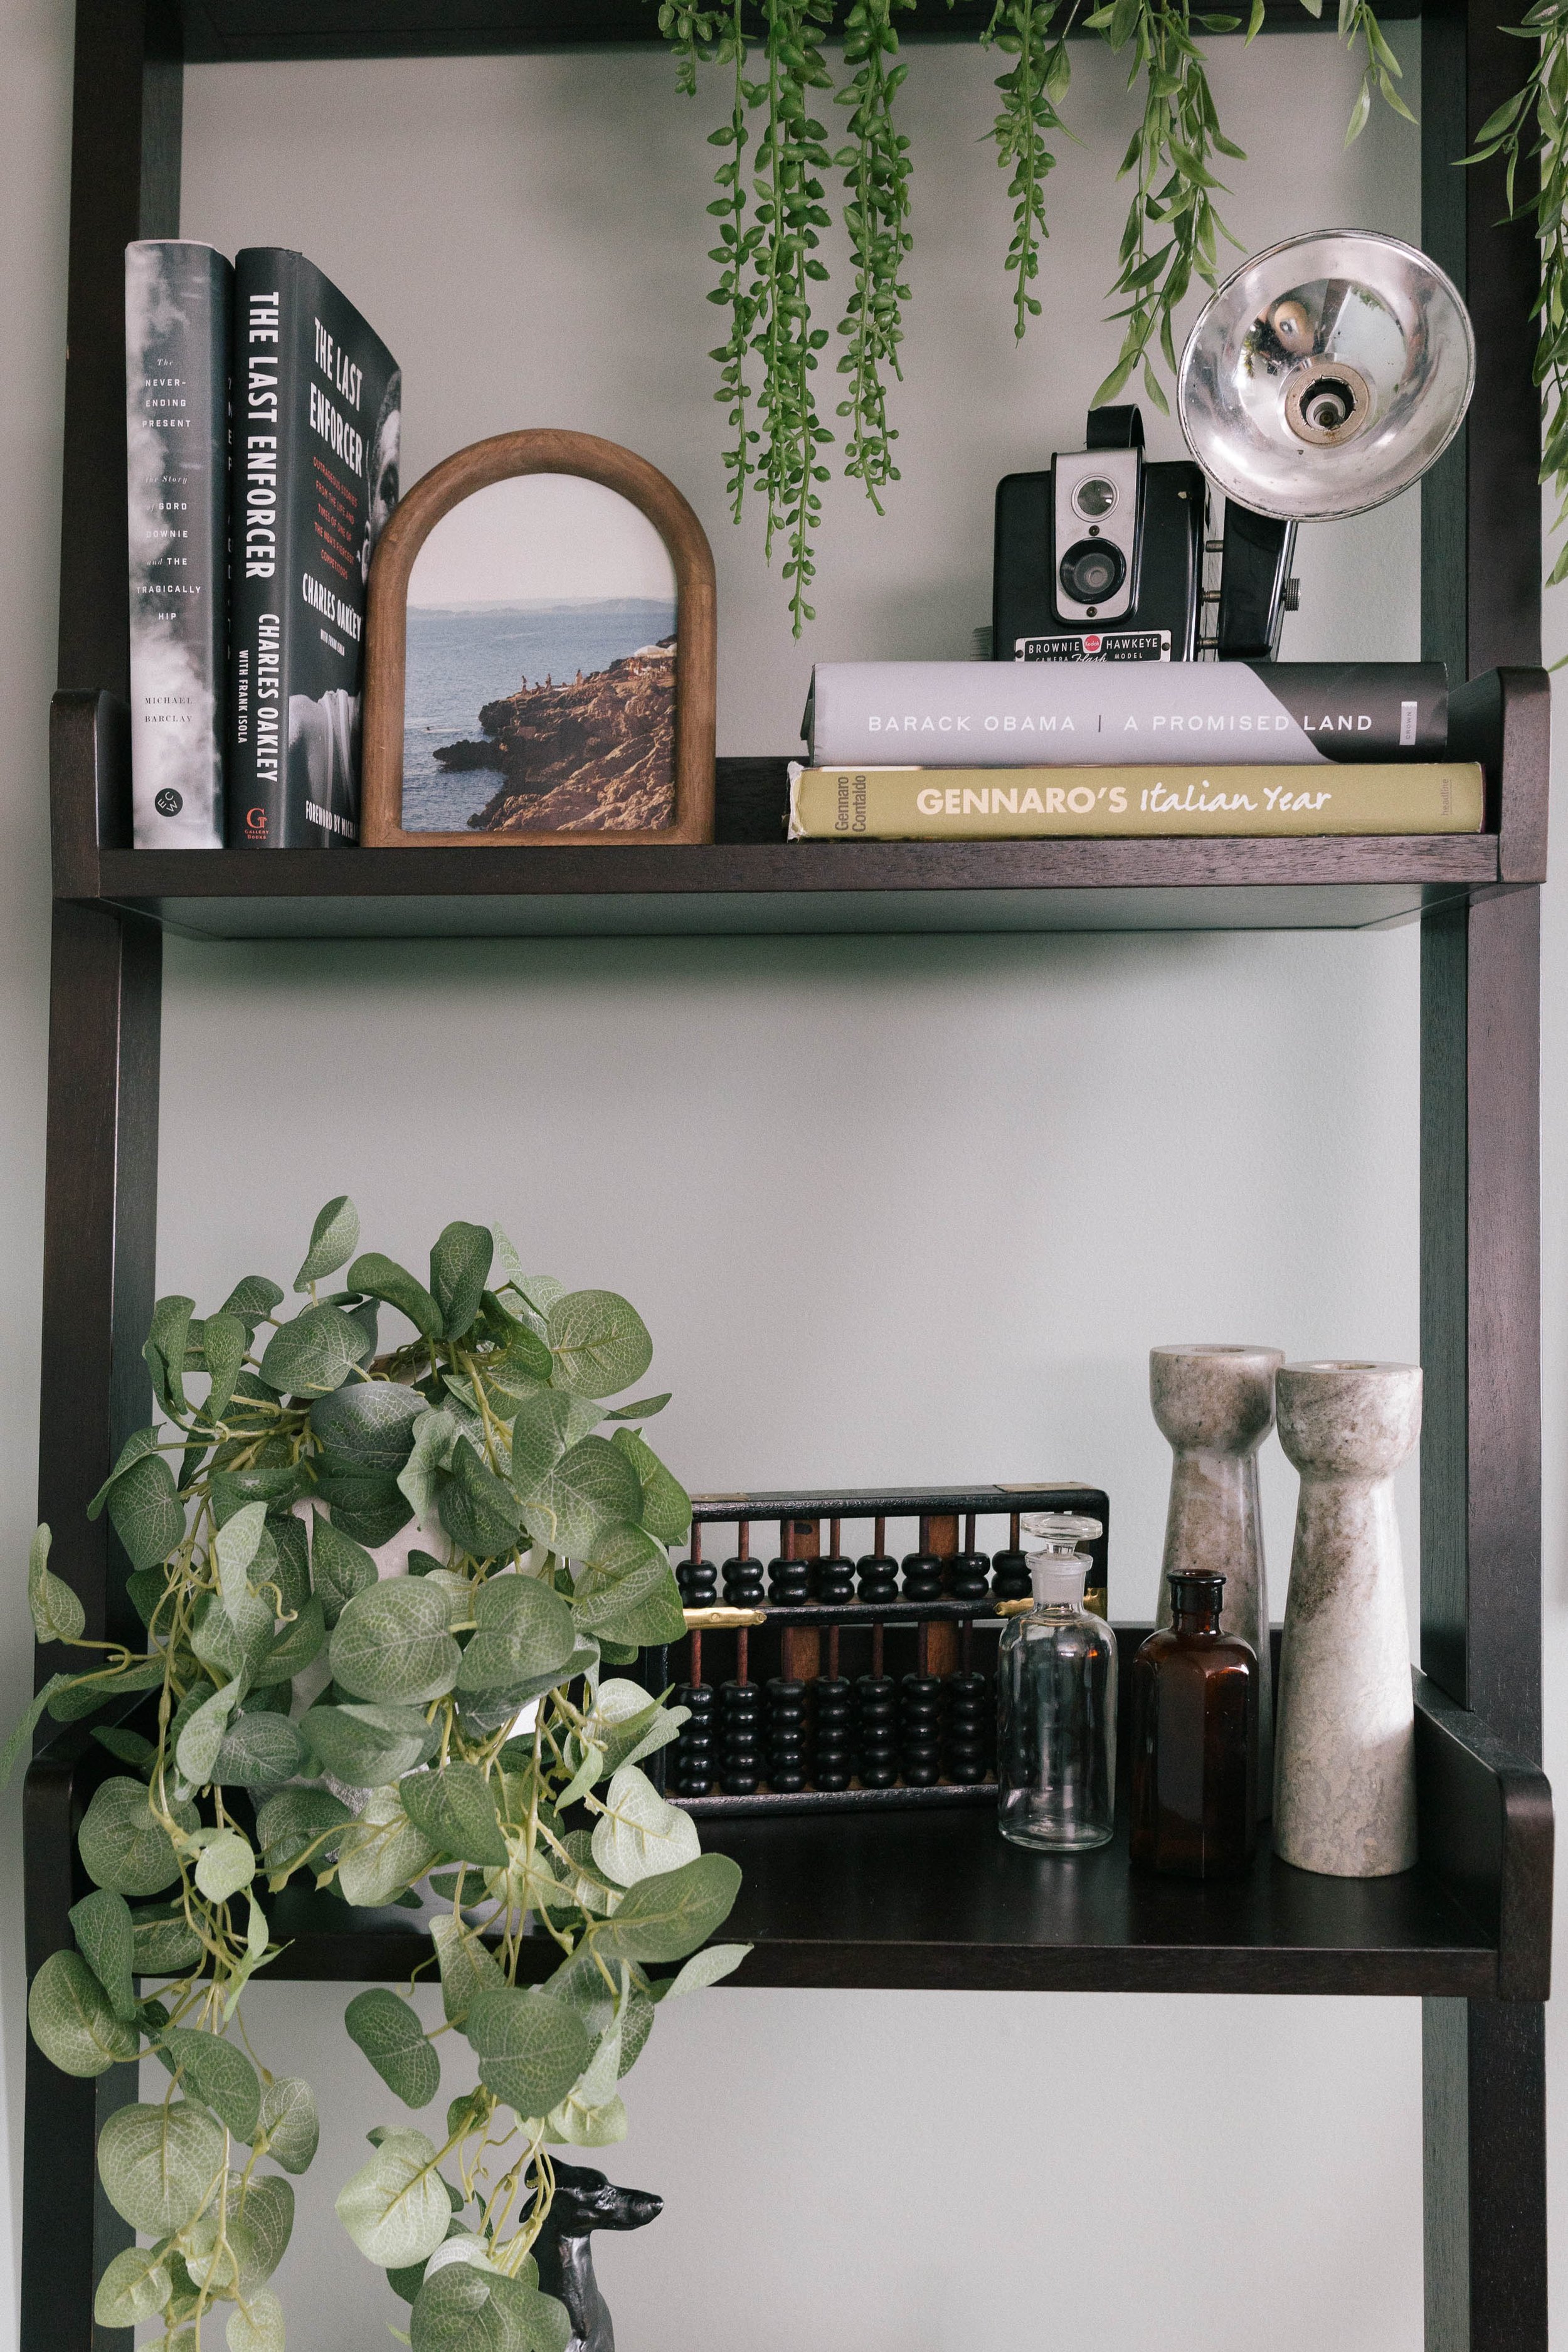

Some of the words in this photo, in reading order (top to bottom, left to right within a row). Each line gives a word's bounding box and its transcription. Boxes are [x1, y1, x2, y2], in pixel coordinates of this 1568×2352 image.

[249, 292, 279, 343] THE
[315, 317, 333, 381] THE
[336, 346, 363, 411] LAST
[248, 356, 278, 423] LAST
[142, 420, 191, 428] PRESENT
[310, 381, 363, 478] ENFORCER
[162, 475, 188, 484] Story
[159, 502, 188, 511] GORD
[246, 435, 277, 578] ENFORCER
[167, 558, 188, 566] THE
[137, 586, 201, 594] TRAGICALLY
[302, 573, 336, 622] CHARLES
[337, 599, 361, 642] OAKLEY
[257, 613, 280, 699] CHARLES
[1029, 642, 1079, 654] BROWNIE
[1071, 653, 1107, 662] Flash
[1106, 638, 1158, 649] HAWKEYE
[239, 650, 249, 675] WITH
[145, 697, 193, 705] MICHAEL
[238, 679, 248, 712] FRANK
[145, 715, 193, 723] BARCLAY
[238, 715, 248, 744] ISOLA
[868, 716, 971, 731] BARACK
[984, 716, 1075, 731] OBAMA
[1124, 716, 1138, 731] A
[1153, 716, 1290, 731] PROMISED
[1303, 715, 1372, 731] LAND
[257, 706, 279, 783] OAKLEY
[835, 776, 849, 832] Gennaro
[852, 775, 867, 833] Contaldo
[916, 787, 1128, 815] GENNARO'S
[1140, 780, 1258, 813] Italian
[1263, 785, 1332, 812] Year
[305, 800, 332, 830] FOREWORD
[334, 814, 340, 834] BY
